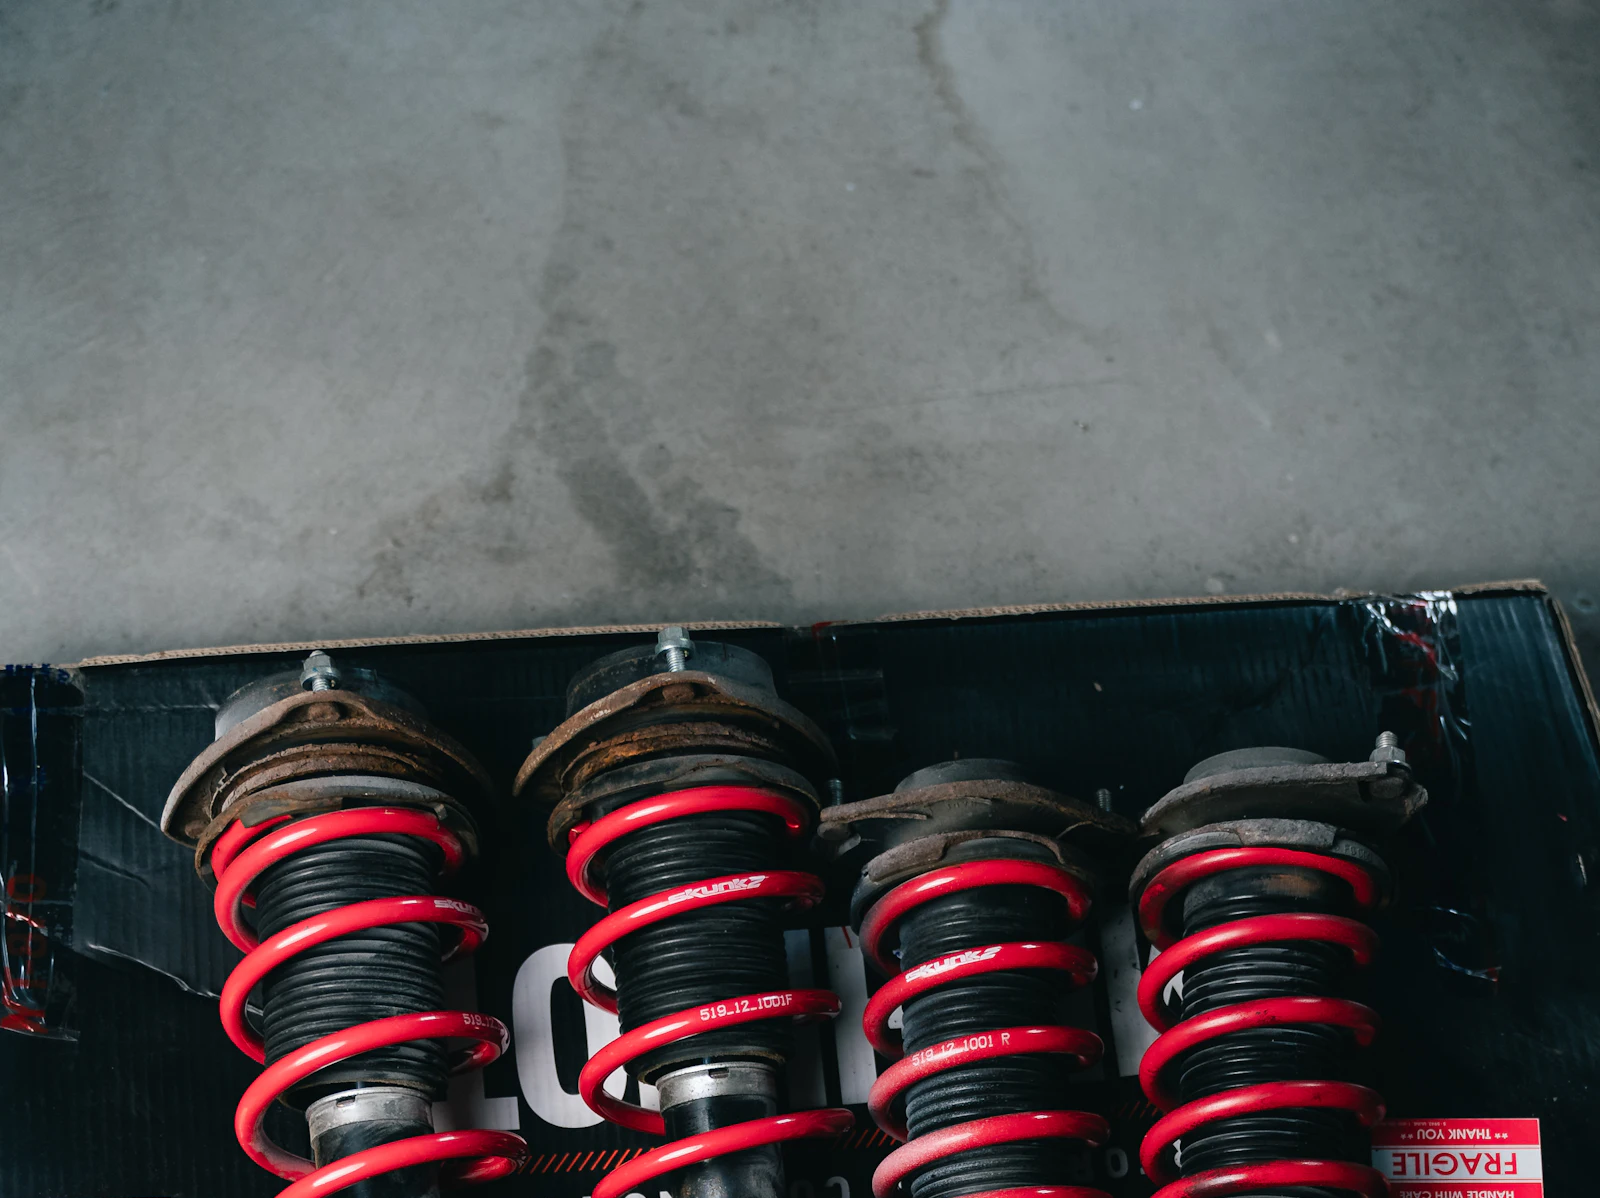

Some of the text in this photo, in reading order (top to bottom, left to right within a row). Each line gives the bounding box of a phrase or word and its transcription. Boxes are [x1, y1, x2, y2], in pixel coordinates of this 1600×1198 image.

[1000, 1032, 1011, 1046] R
[1416, 1128, 1492, 1140] THANK YOU
[1392, 1152, 1518, 1176] FRAGILE
